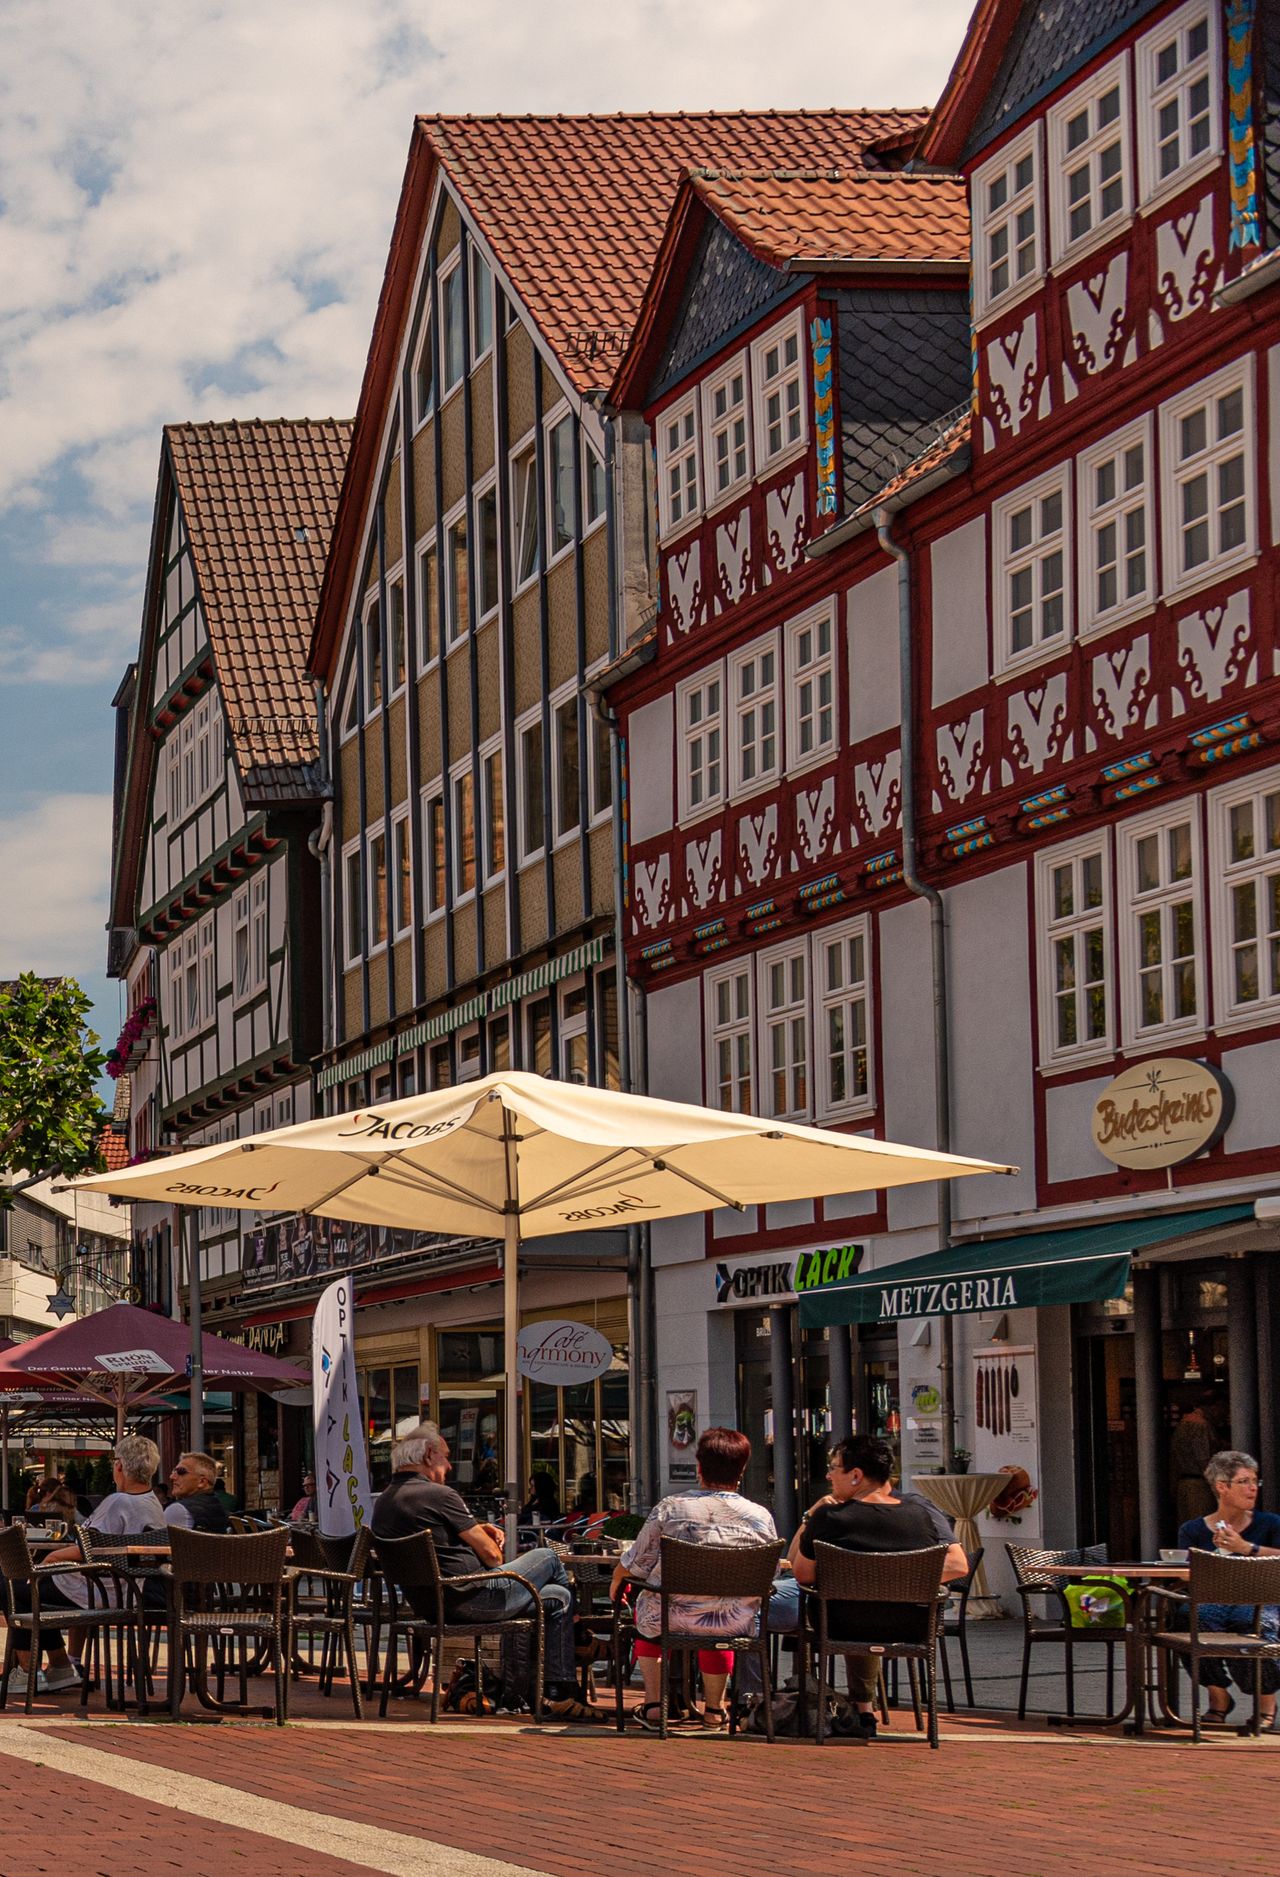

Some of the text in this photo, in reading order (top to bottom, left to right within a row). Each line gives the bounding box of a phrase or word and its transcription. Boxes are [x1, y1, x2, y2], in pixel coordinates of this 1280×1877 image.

[338, 1113, 461, 1140] JACOBS
[732, 1244, 862, 1298] OPTIK LACK
[879, 1275, 1018, 1318] METZGERIA
[105, 1353, 153, 1364] RHÖN
[337, 1286, 348, 1402] OPTIK
[111, 1360, 158, 1368] SPRUDEL
[221, 1369, 254, 1377] Natur
[343, 1413, 364, 1529] LACK
